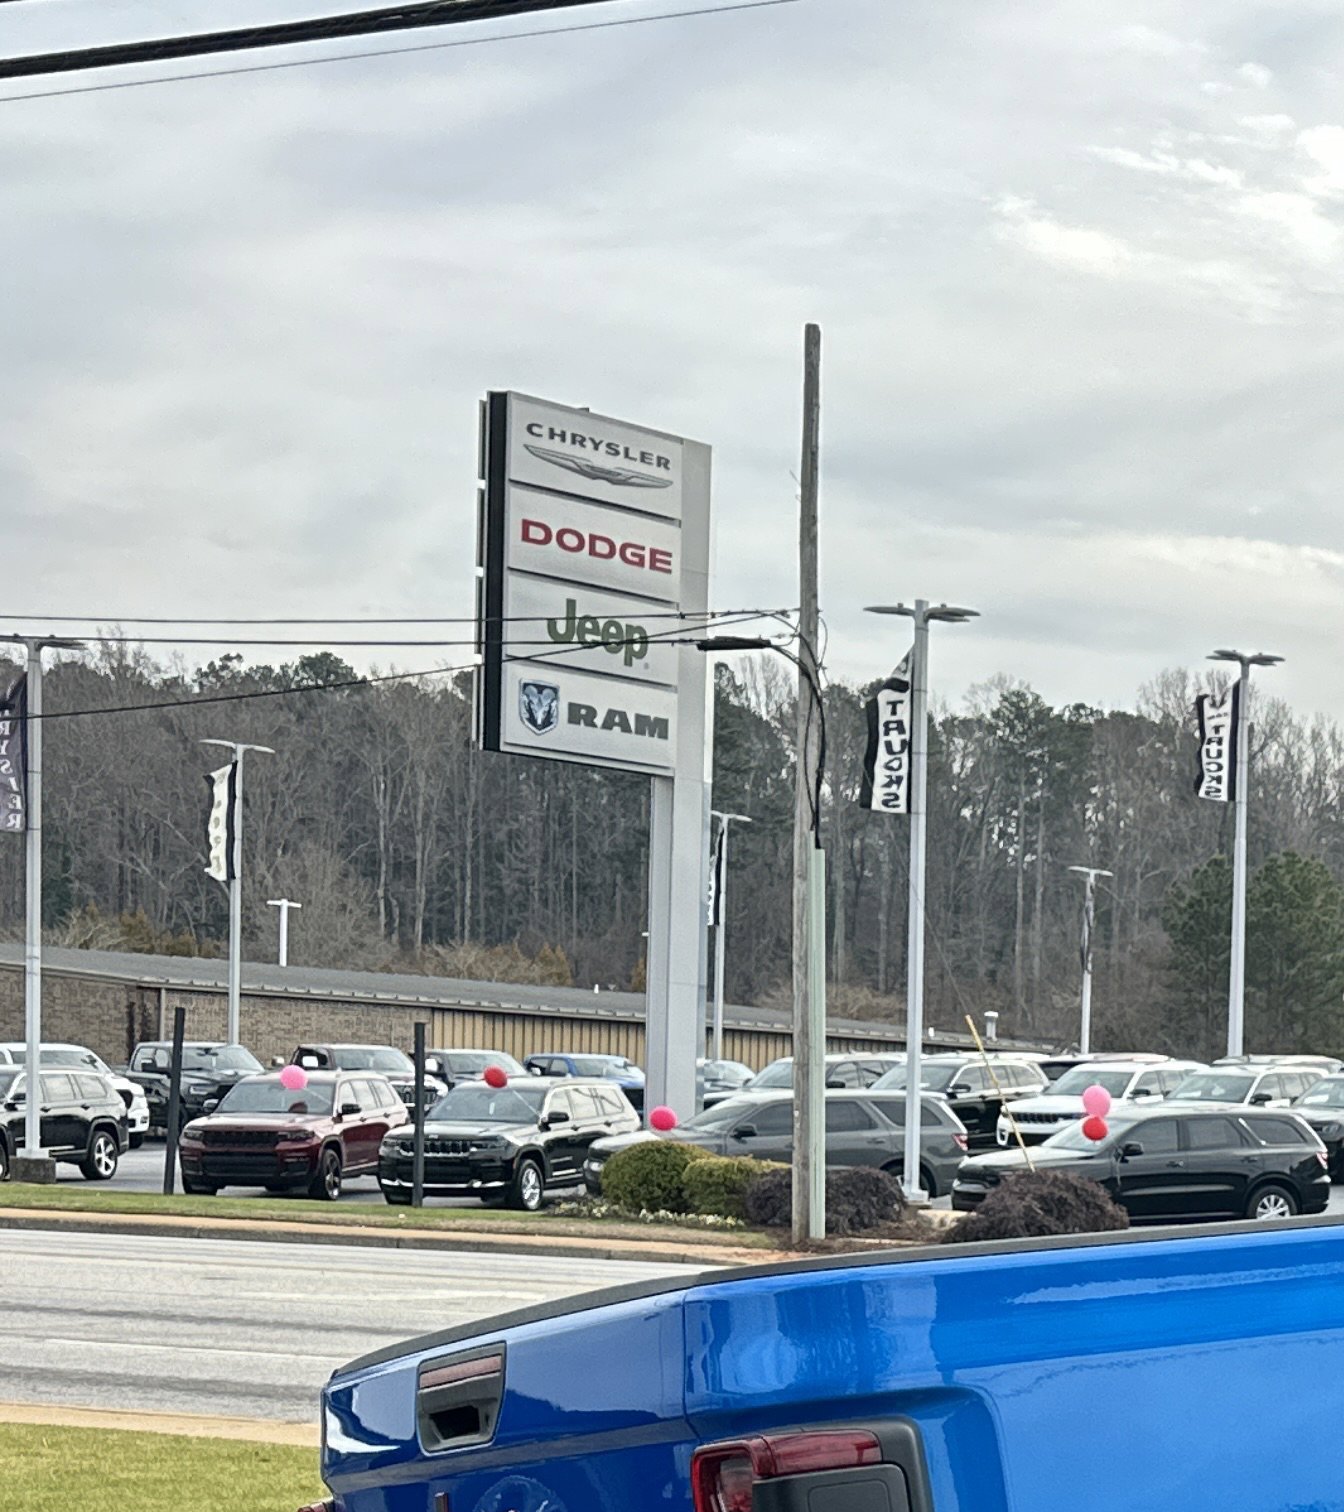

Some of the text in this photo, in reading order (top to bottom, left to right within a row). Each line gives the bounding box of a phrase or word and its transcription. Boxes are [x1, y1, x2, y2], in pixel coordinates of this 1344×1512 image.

[526, 423, 671, 470] CHRYSLER
[521, 519, 673, 574] DODGE
[547, 598, 648, 667] Jeep
[567, 702, 669, 740] RAM
